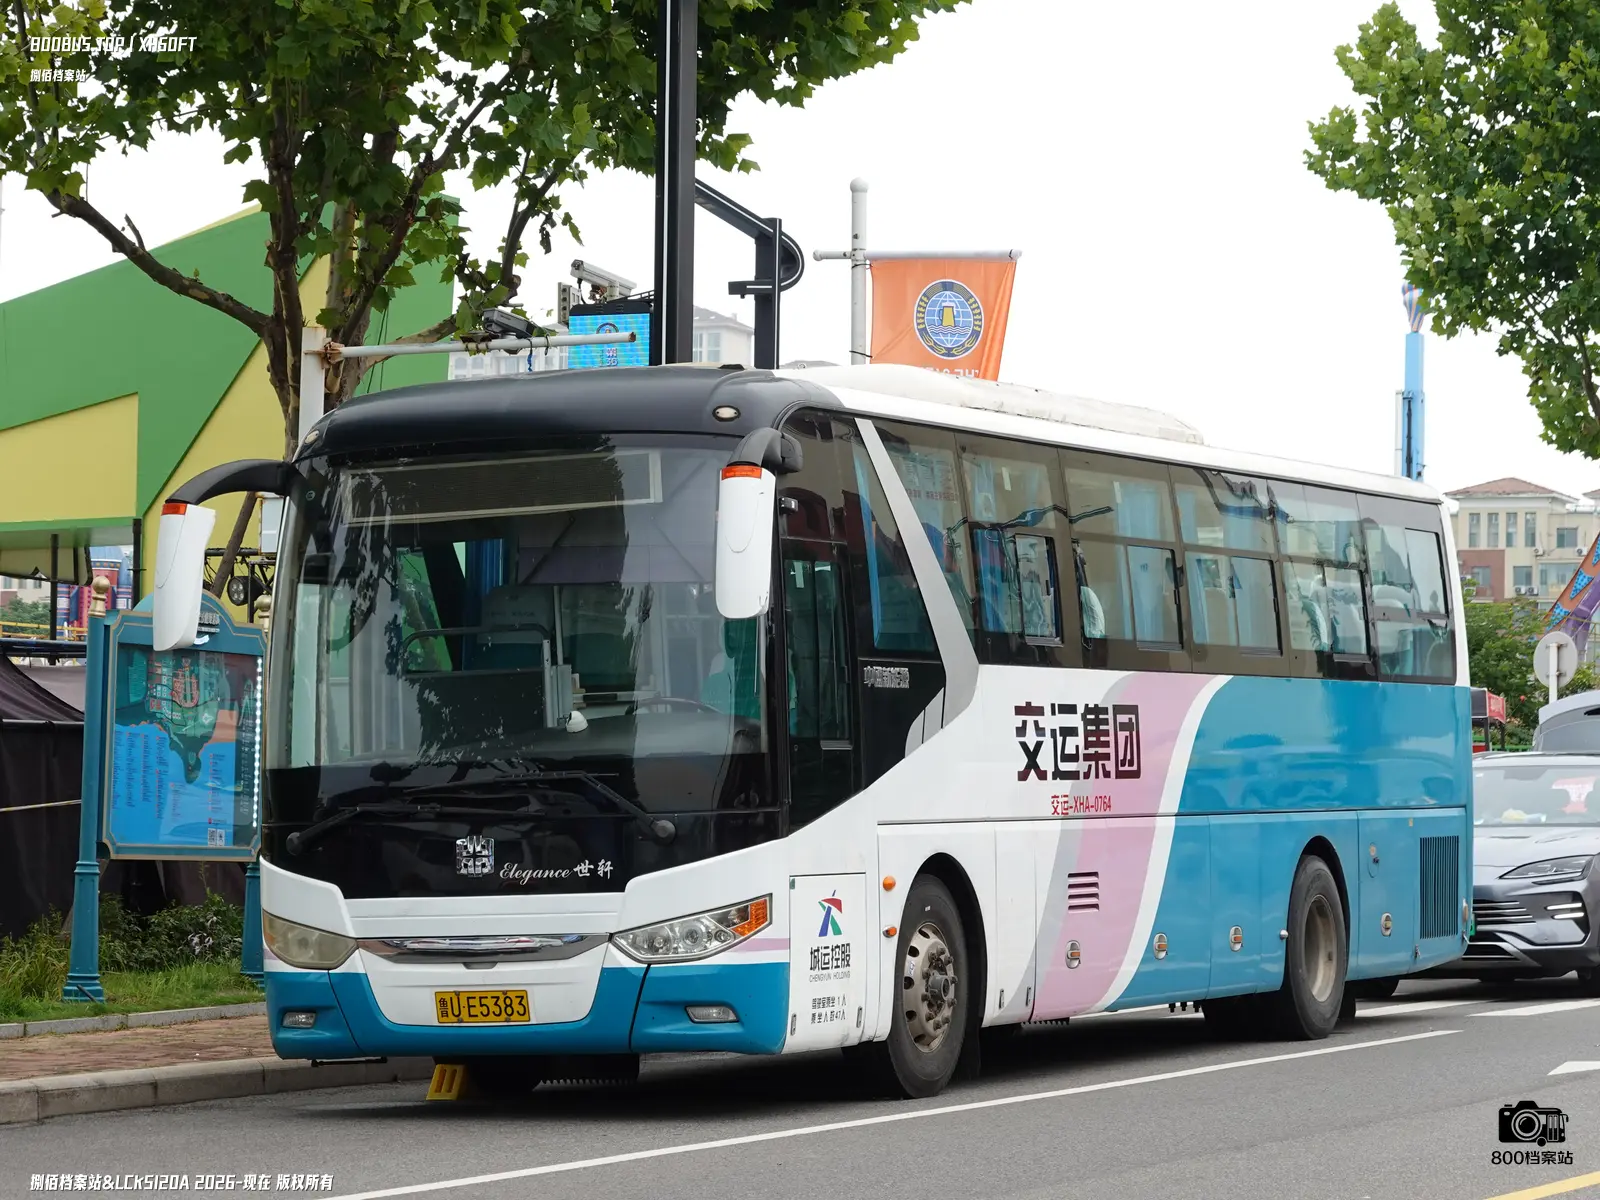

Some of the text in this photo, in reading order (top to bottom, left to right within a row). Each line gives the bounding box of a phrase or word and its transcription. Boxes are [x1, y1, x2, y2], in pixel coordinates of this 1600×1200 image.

[1013, 701, 1142, 782] 交运集团
[1050, 794, 1112, 816] 交运-XHA-0764
[499, 859, 614, 885] Elegance 世轩
[810, 943, 851, 971] 城运控股
